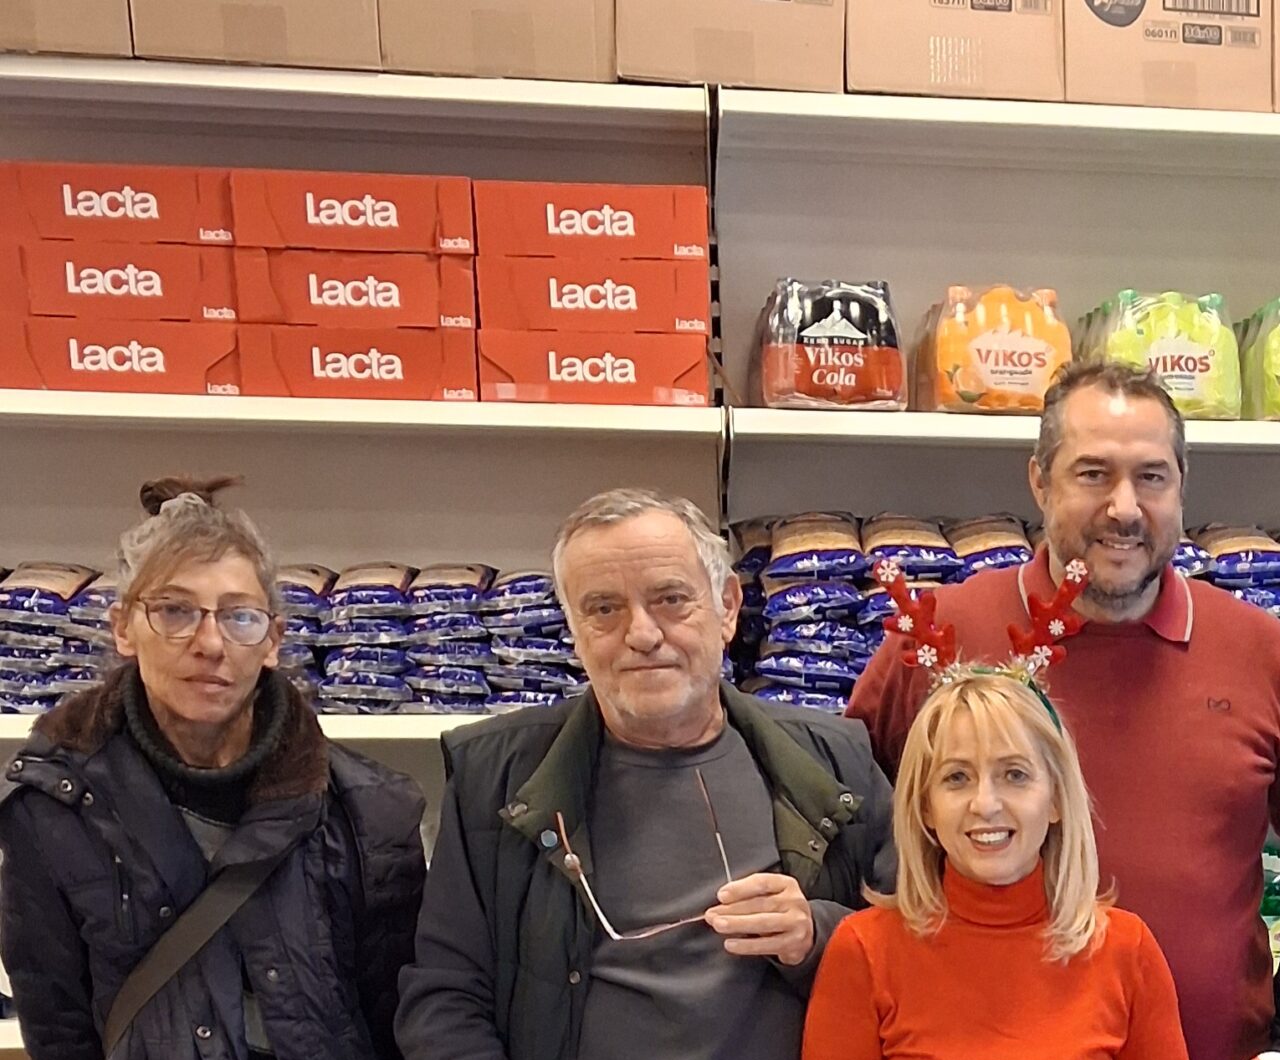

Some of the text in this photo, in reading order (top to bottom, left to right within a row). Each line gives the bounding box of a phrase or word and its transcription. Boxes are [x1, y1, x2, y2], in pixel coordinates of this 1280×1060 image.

[63, 184, 159, 219] Lacta
[306, 193, 399, 228] Lacta
[547, 203, 635, 237] Lacta
[66, 262, 163, 297] Lacta
[309, 274, 400, 308] Lacta
[549, 278, 638, 311] Lacta
[69, 339, 166, 373] Lacta
[312, 347, 403, 380] Lacta
[549, 351, 636, 384] Lacta
[803, 345, 864, 367] Vikos
[976, 348, 1047, 368] VIKOS
[812, 368, 857, 386] Cola
